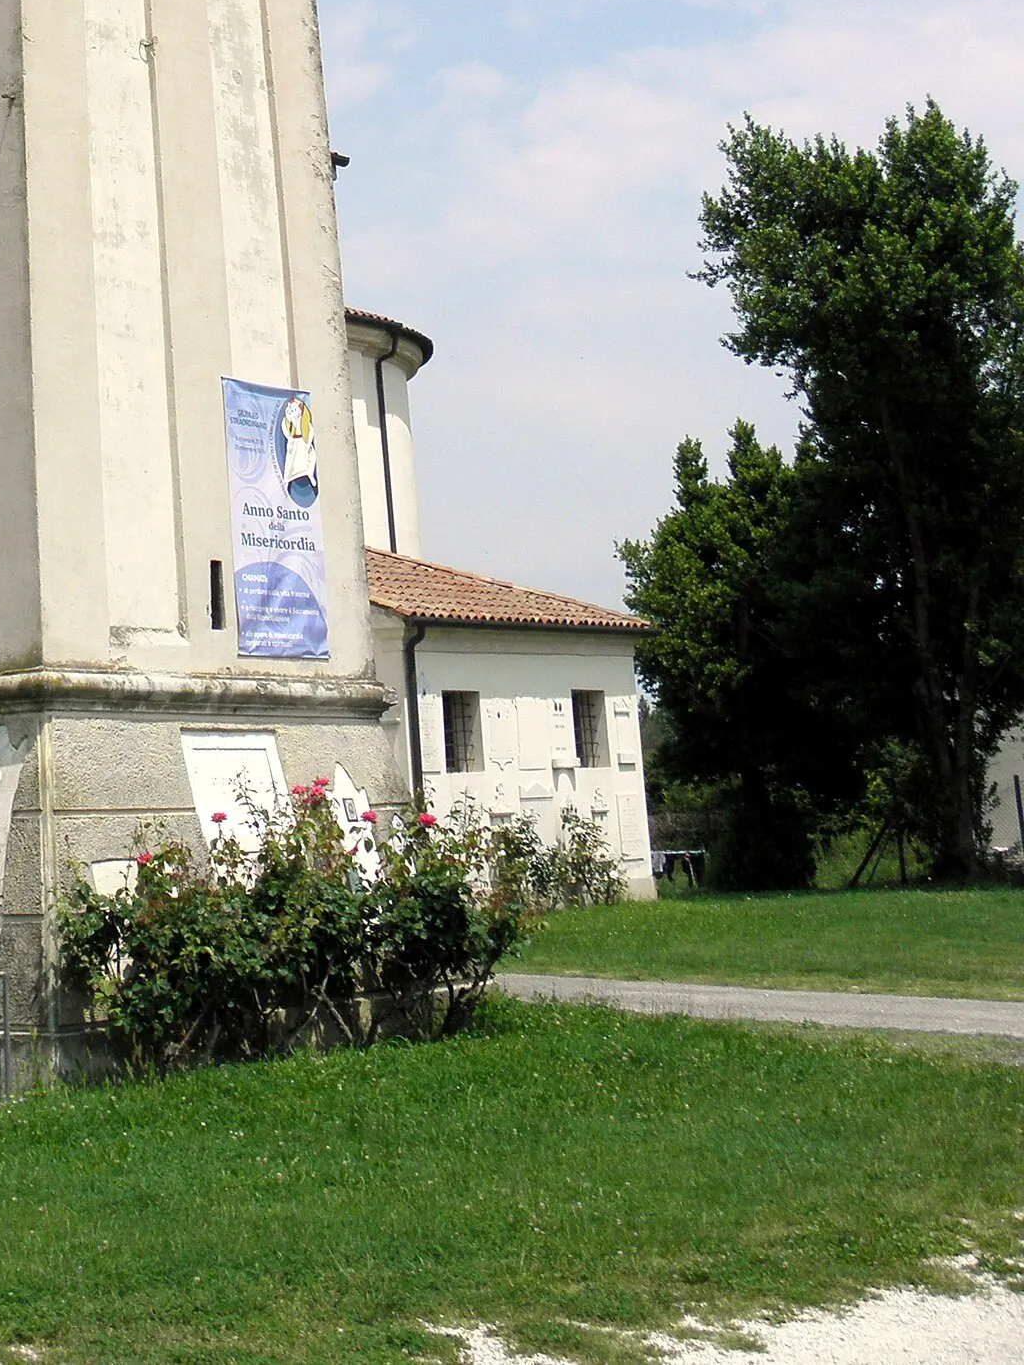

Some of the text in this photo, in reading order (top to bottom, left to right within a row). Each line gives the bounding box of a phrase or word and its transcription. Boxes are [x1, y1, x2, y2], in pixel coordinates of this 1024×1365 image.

[243, 502, 310, 521] Anno Santo
[268, 522, 285, 531] della
[241, 533, 316, 551] Misericordia
